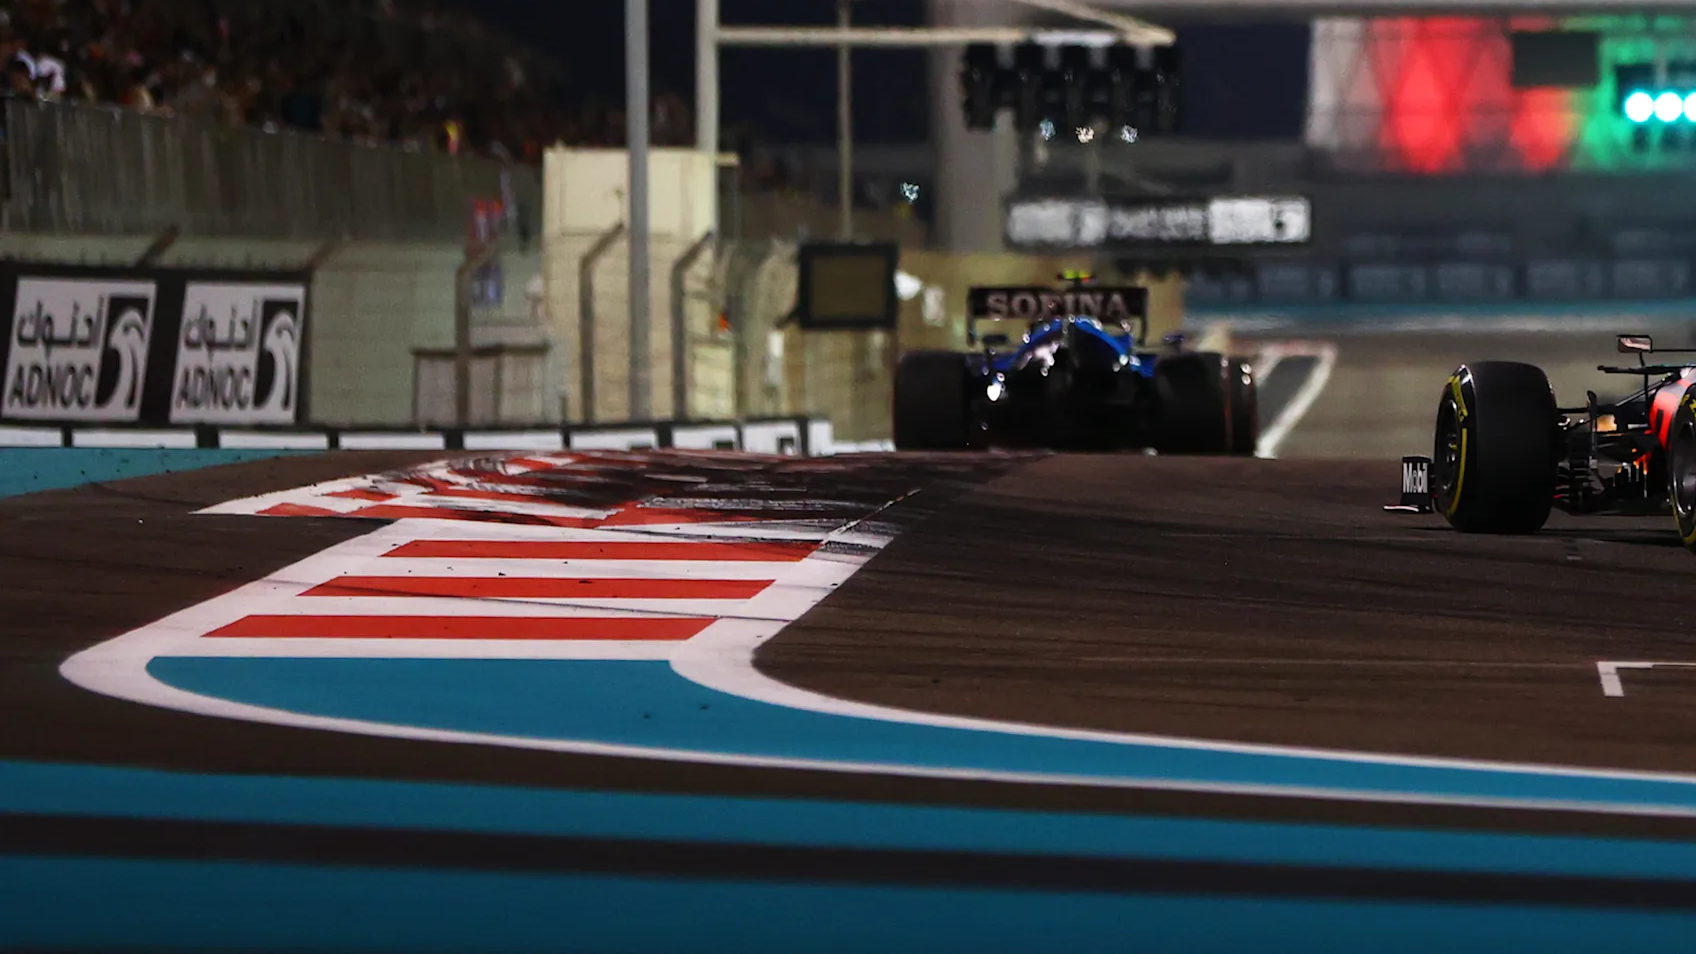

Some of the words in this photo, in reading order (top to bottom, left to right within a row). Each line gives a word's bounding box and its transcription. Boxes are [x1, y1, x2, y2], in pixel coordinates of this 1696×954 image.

[986, 291, 1130, 319] SOFINA
[8, 362, 95, 409] ADNOC
[174, 365, 251, 411] ADNOC
[1402, 462, 1429, 494] Mobil
